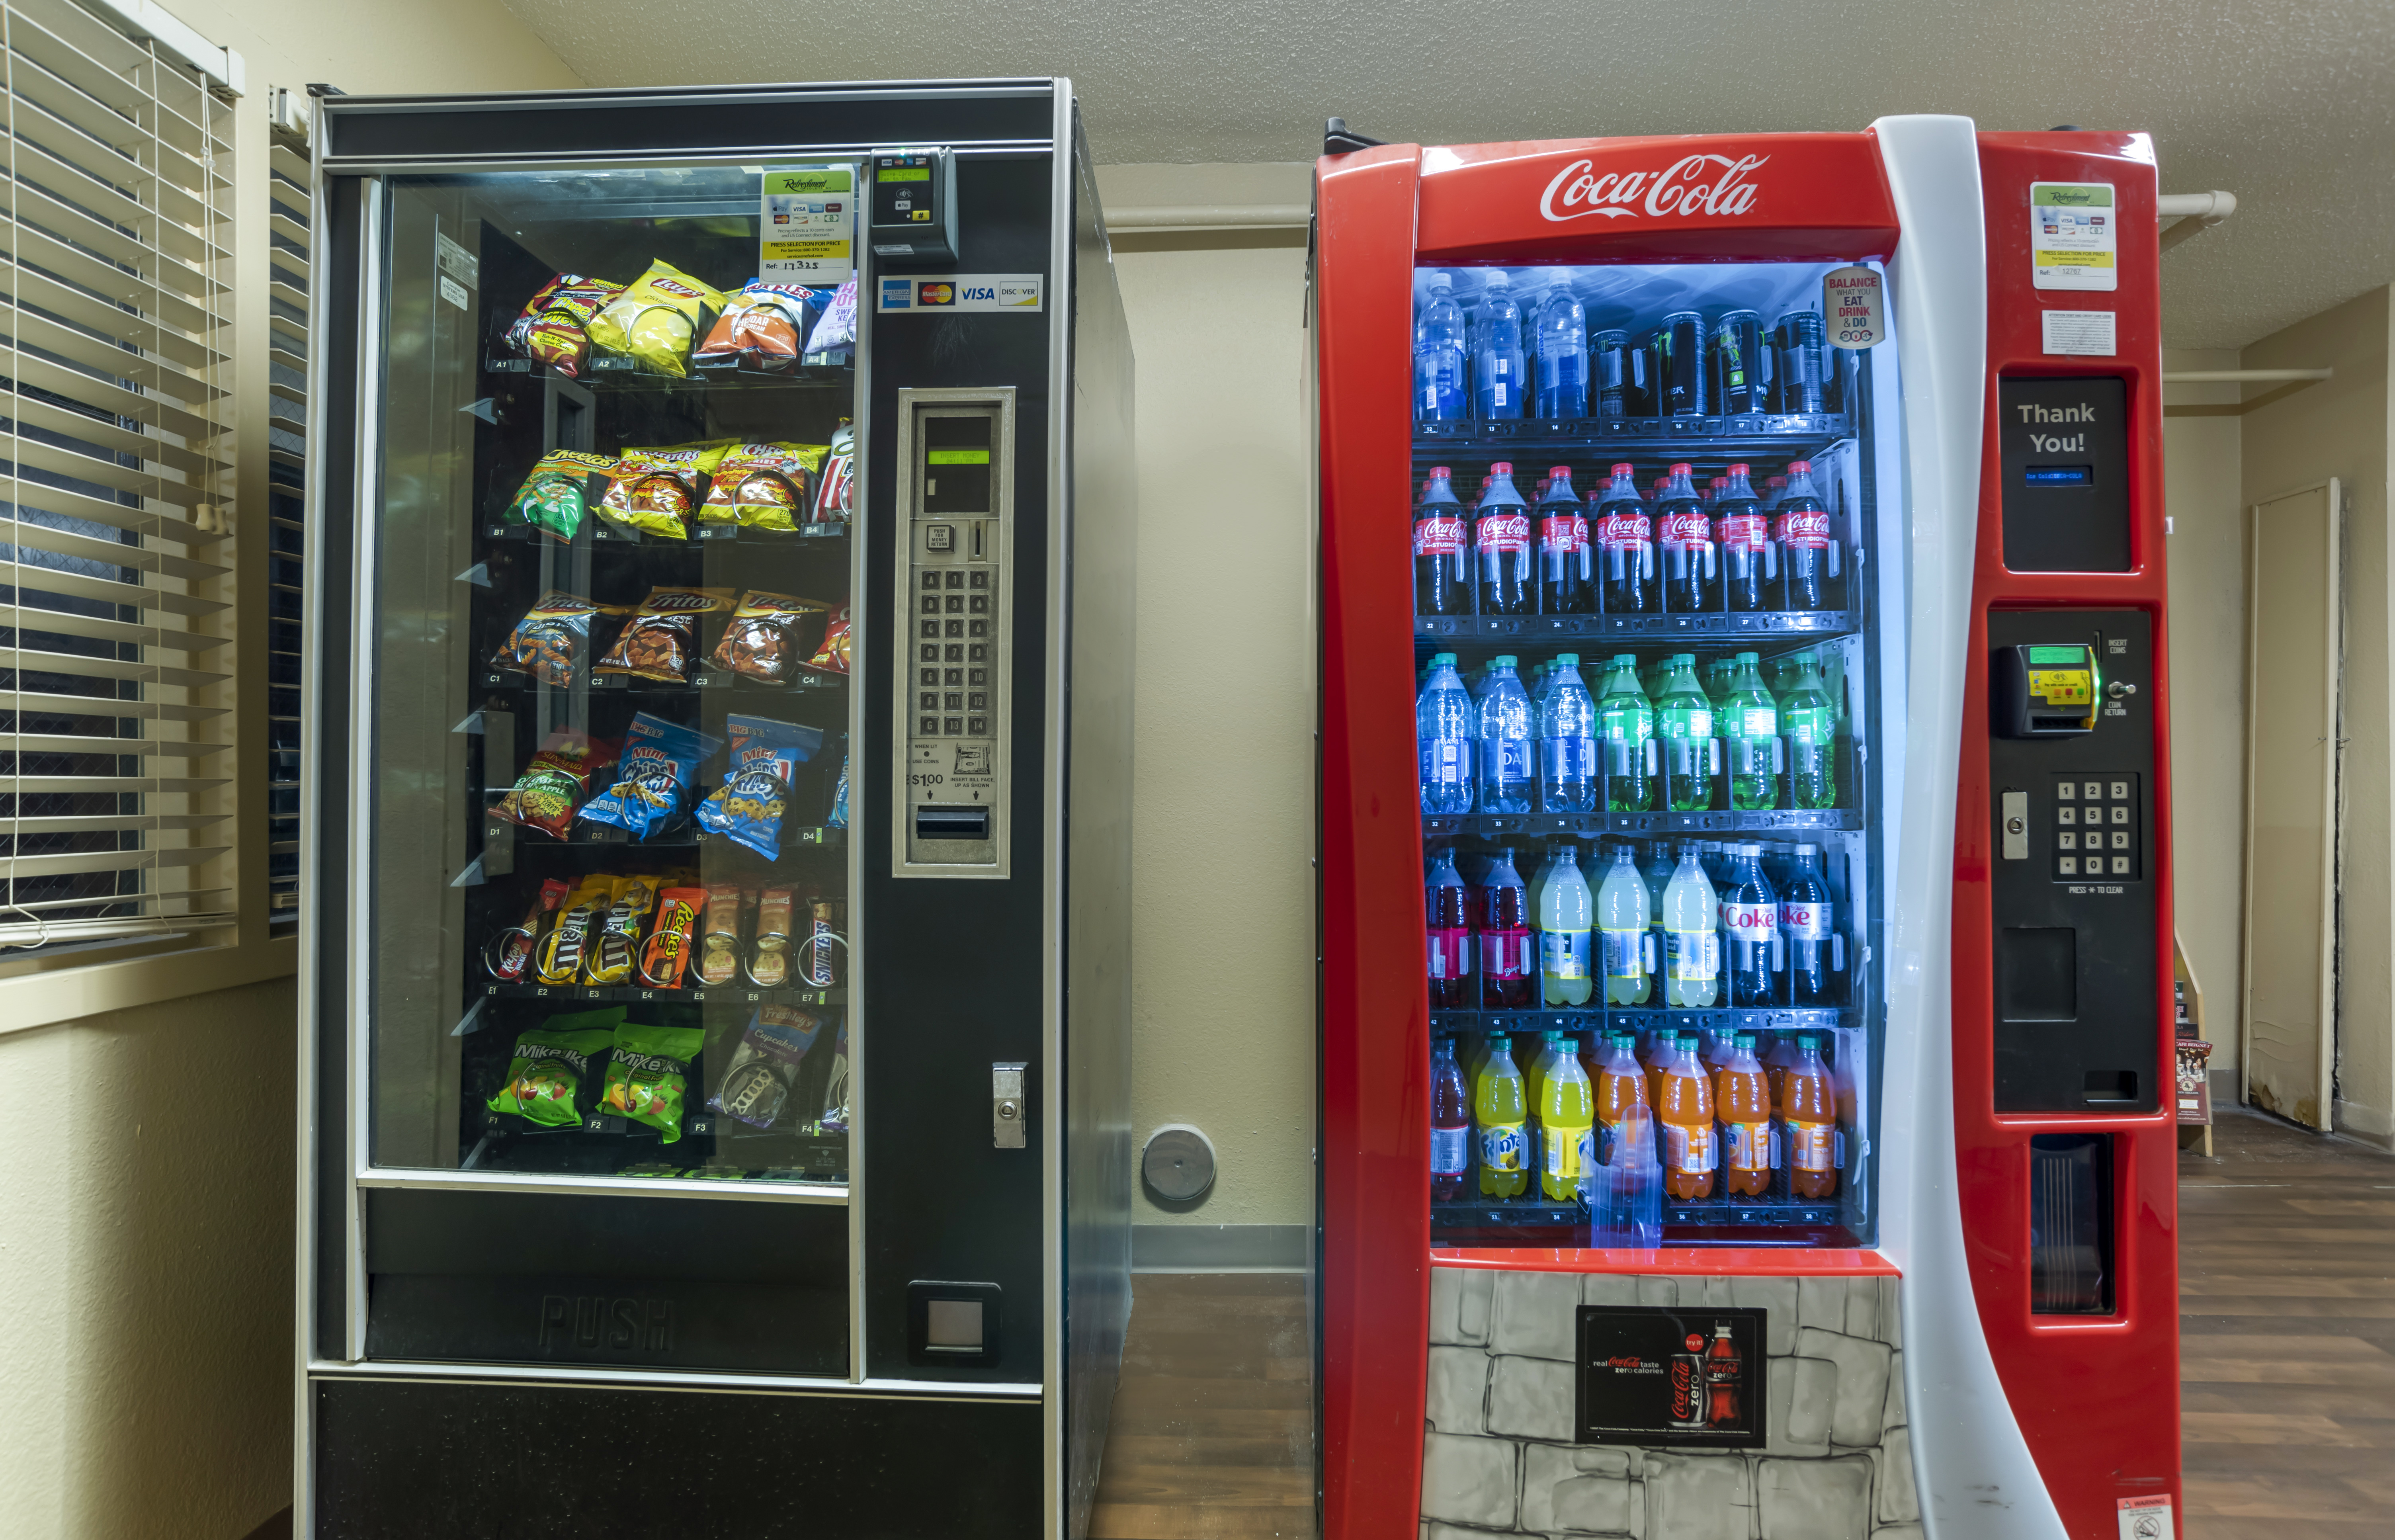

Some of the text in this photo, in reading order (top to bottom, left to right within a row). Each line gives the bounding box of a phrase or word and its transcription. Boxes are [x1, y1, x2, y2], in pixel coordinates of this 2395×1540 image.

[783, 179, 827, 192] Refreshment
[1540, 154, 1771, 221] Coca-Cola
[784, 261, 819, 270] 17325
[652, 279, 704, 297] Lay's
[1829, 278, 1877, 288] BALANCE
[447, 292, 457, 302] 4062
[922, 290, 951, 299] MasterCard
[961, 288, 994, 300] VISA
[1839, 307, 1871, 317] DRINK
[747, 324, 766, 332] CREAM
[1844, 317, 1866, 327] & DO
[2018, 403, 2095, 423] Thank
[2030, 433, 2084, 452] You!
[544, 449, 619, 467] Cheetos
[648, 594, 717, 608] Fritos
[672, 655, 683, 665] 320
[630, 721, 664, 738] BIG BAG
[729, 724, 764, 737] BIG BAG
[631, 747, 668, 761] Mini
[742, 747, 777, 764] Mini
[912, 774, 943, 786] $1.00
[540, 786, 566, 795] APPLE
[543, 800, 555, 813] FIBER
[547, 799, 559, 811] GRAMS
[710, 893, 740, 903] MUNCHIES
[760, 896, 790, 906] MUNCHIES
[1725, 906, 1774, 928] Coke
[665, 901, 693, 959] Reese's
[502, 942, 522, 973] Kit Kat
[815, 921, 832, 983] SNICKERS
[515, 953, 528, 971] BIG KAT
[766, 1008, 813, 1028] Freshley's
[754, 1028, 799, 1052] Cupcakes
[514, 1044, 560, 1059] Mike
[760, 1043, 788, 1057] Chocolate
[612, 1048, 660, 1071] Mike
[539, 1296, 674, 1350] PUSH
[1608, 1356, 1641, 1367] Coca-Cola
[1708, 1362, 1738, 1373] Coca-Cola
[1672, 1360, 1690, 1419] Coca-Cola
